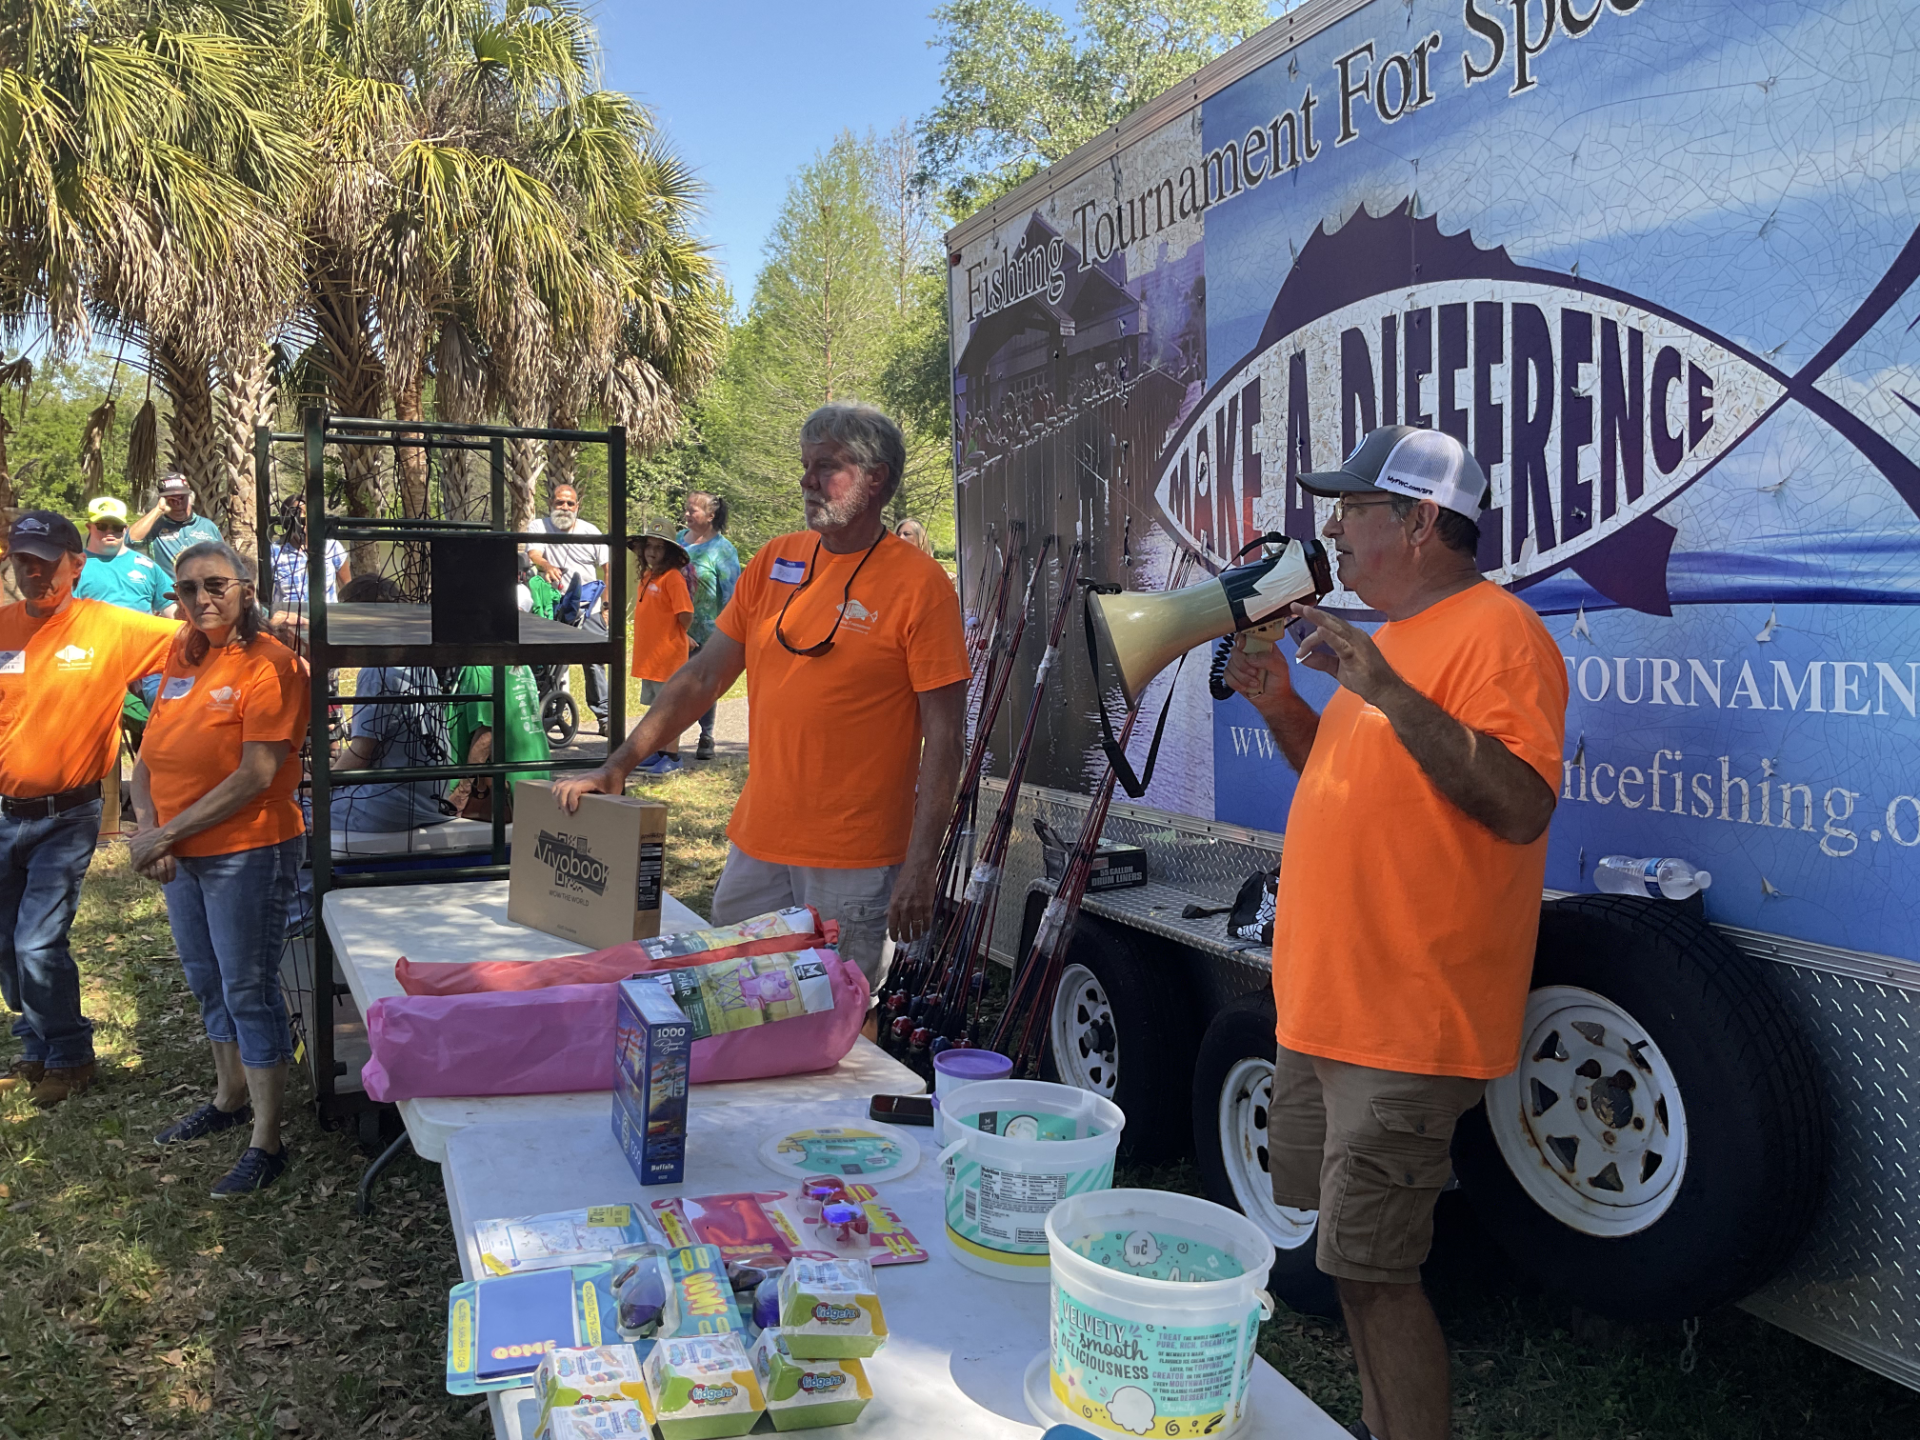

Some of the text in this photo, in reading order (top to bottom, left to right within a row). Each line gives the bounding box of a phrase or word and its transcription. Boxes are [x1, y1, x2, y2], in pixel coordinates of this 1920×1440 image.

[967, 0, 1645, 323] Fishing Tournament For Sp
[1168, 376, 1263, 566] MAKE
[1284, 348, 1316, 541] A
[1110, 866, 1133, 876] GALLON
[1092, 875, 1114, 886] DRUM
[1116, 872, 1142, 883] LINERS
[677, 972, 691, 997] CHAIR
[657, 1027, 686, 1038] 1000
[650, 1164, 674, 1172] Buffalo
[1063, 1299, 1126, 1344] VELVETY
[1158, 1333, 1181, 1341] TREAT
[1200, 1338, 1225, 1348] CREAMY
[1079, 1332, 1149, 1361] smooth
[1062, 1332, 1149, 1380] DELICIOUSNESS
[1194, 1361, 1224, 1371] TOPPINGS
[1152, 1371, 1184, 1379] CREATOR
[1169, 1375, 1223, 1388] MOUTHWATERING
[1180, 1393, 1207, 1402] DESSERT
